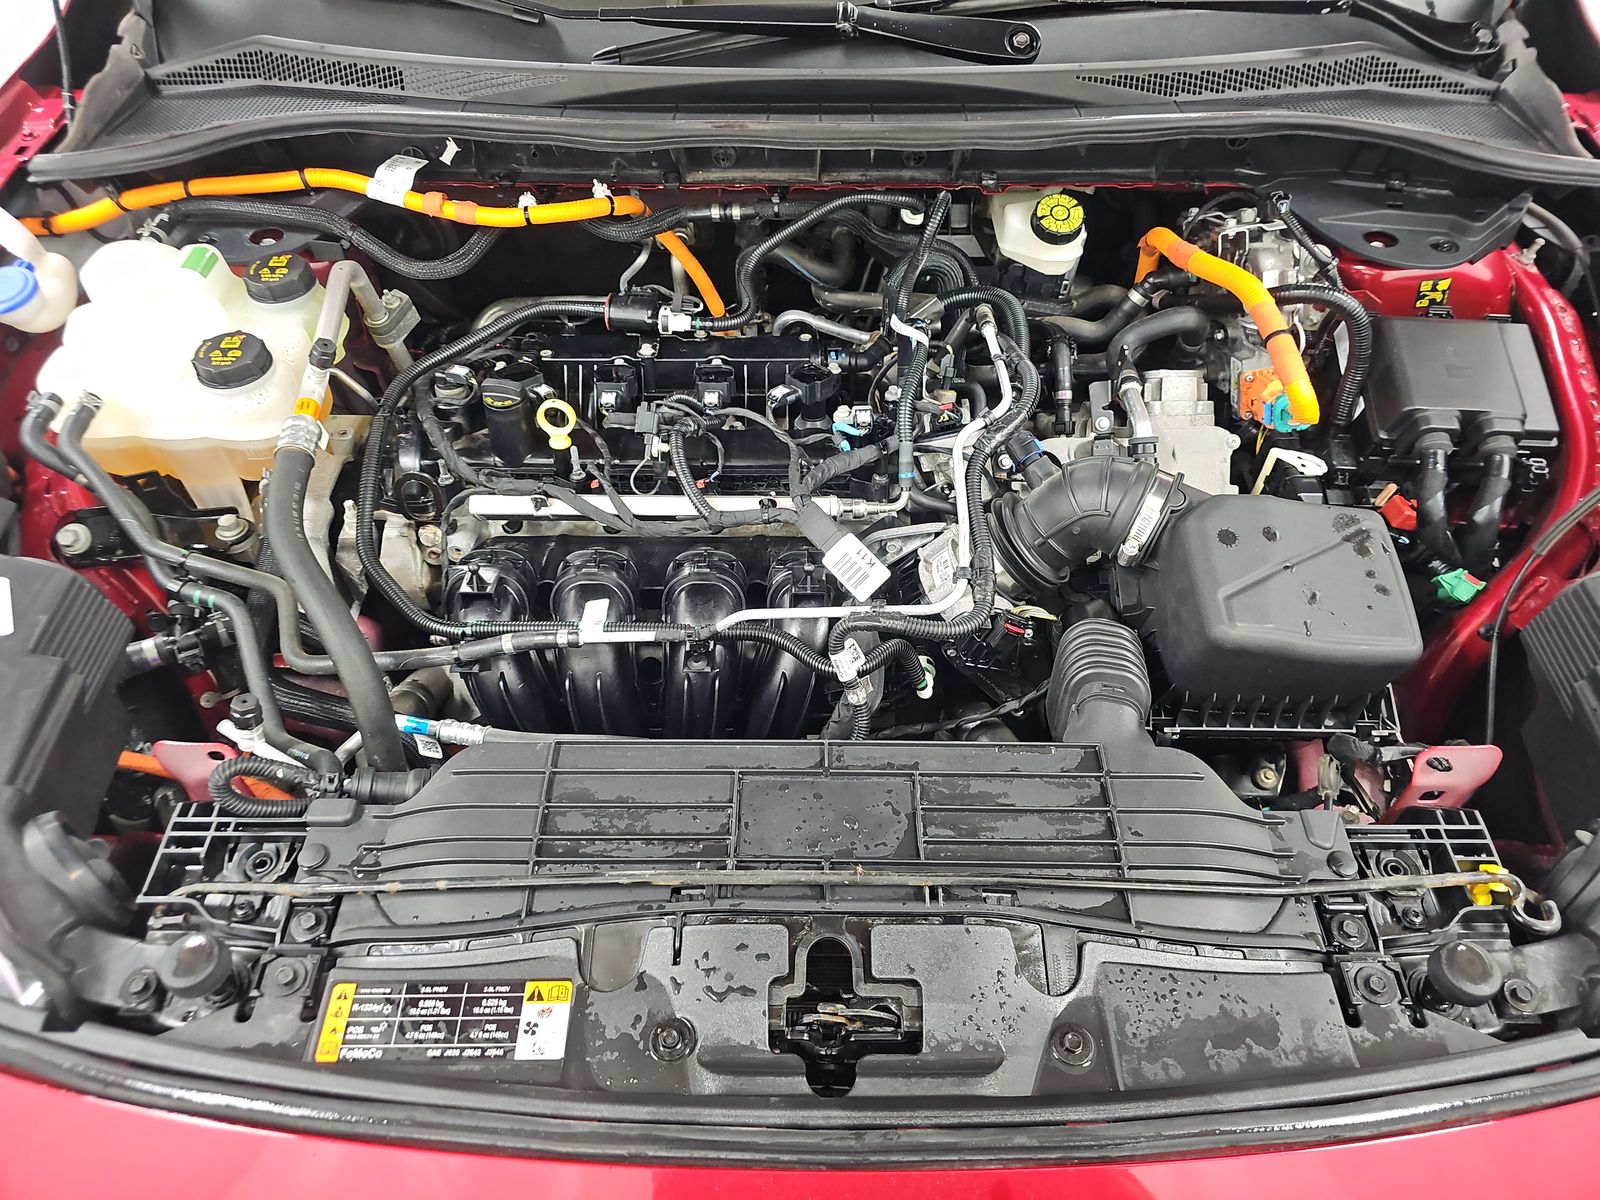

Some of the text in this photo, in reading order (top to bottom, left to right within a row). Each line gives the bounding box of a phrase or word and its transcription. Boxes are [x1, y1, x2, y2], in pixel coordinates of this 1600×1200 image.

[855, 547, 877, 569] K11
[351, 1002, 385, 1013] R-1234yf
[436, 999, 445, 1009] kg
[498, 998, 508, 1008] kg
[339, 1047, 383, 1059] FoMoCo
